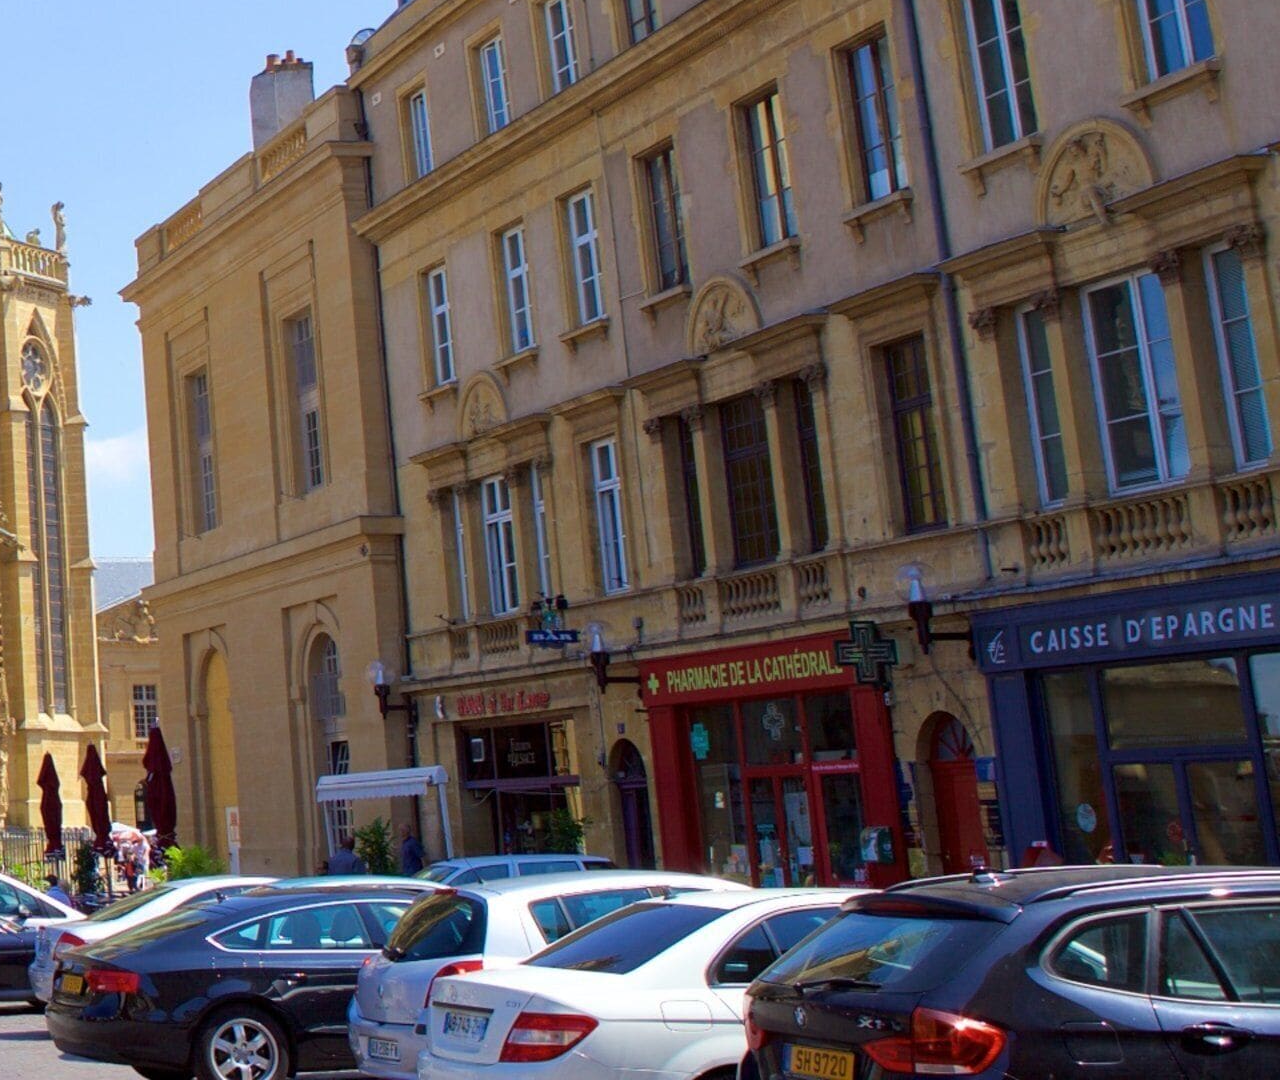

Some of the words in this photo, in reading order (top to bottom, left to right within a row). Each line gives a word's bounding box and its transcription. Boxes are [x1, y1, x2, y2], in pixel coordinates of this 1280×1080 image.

[532, 629, 572, 641] BAR
[1030, 623, 1109, 653] CAISSE
[1126, 603, 1276, 644] D'EPARGNE
[666, 663, 728, 694] PHARMACIE
[729, 661, 745, 686] DE
[747, 659, 763, 684] LA
[795, 1049, 811, 1073] SH
[813, 1052, 847, 1077] 9720
